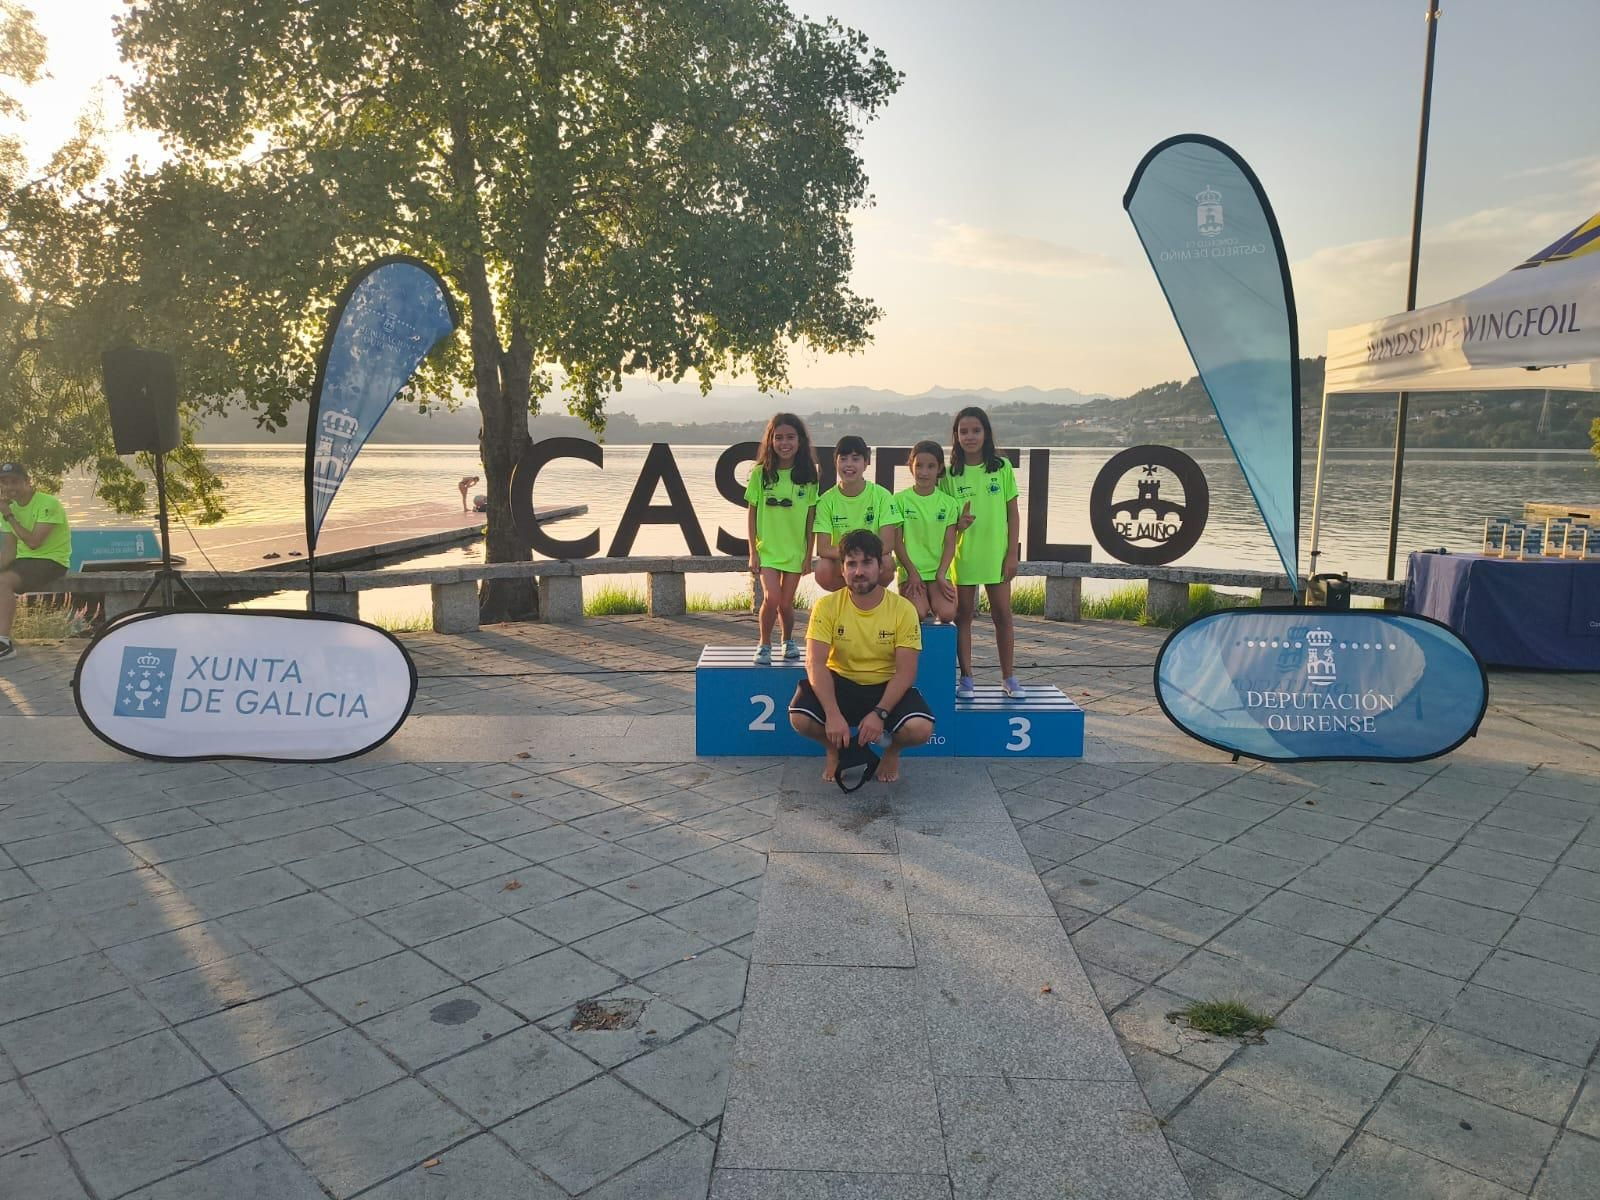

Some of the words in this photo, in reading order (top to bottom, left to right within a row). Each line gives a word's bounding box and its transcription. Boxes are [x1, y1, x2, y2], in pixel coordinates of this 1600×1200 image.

[1116, 523, 1133, 537] DE
[1137, 522, 1178, 538] MIÑO
[187, 655, 302, 684] XUNTA
[180, 688, 224, 714] DE
[235, 690, 369, 719] GALICIA
[748, 694, 776, 731] 2
[1247, 688, 1395, 712] DEPUTACIÓN
[1006, 717, 1032, 752] 3
[1267, 714, 1377, 733] OURENSE
